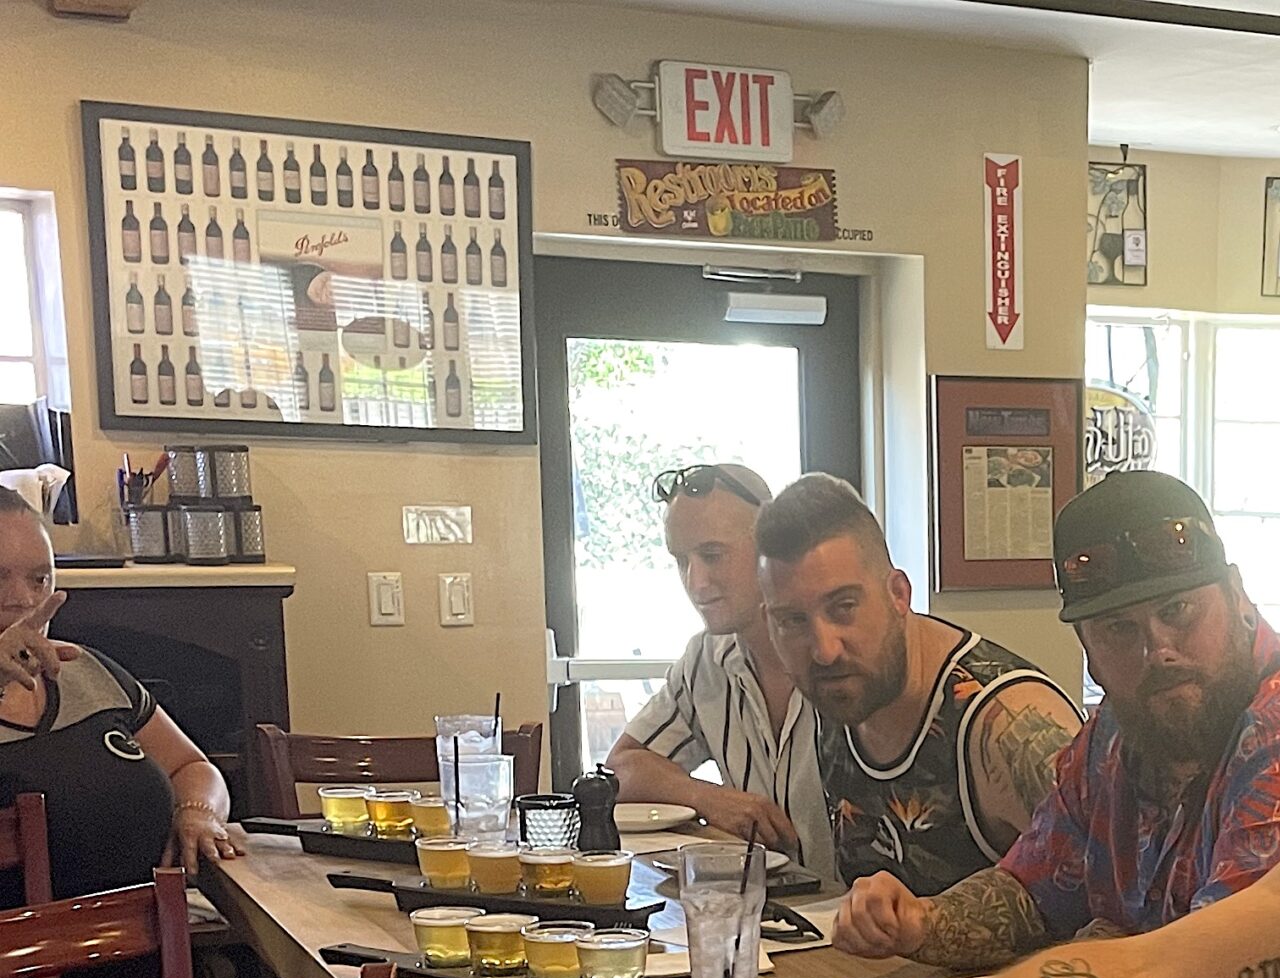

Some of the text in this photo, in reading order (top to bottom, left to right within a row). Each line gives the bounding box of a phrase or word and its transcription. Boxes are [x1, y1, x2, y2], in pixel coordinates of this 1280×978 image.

[685, 68, 775, 147] EXIT
[587, 213, 609, 227] THIS
[836, 227, 873, 241] CCUPIED
[620, 162, 778, 228] Restrooms
[996, 168, 1010, 325] FIRE EXTINGUISHER
